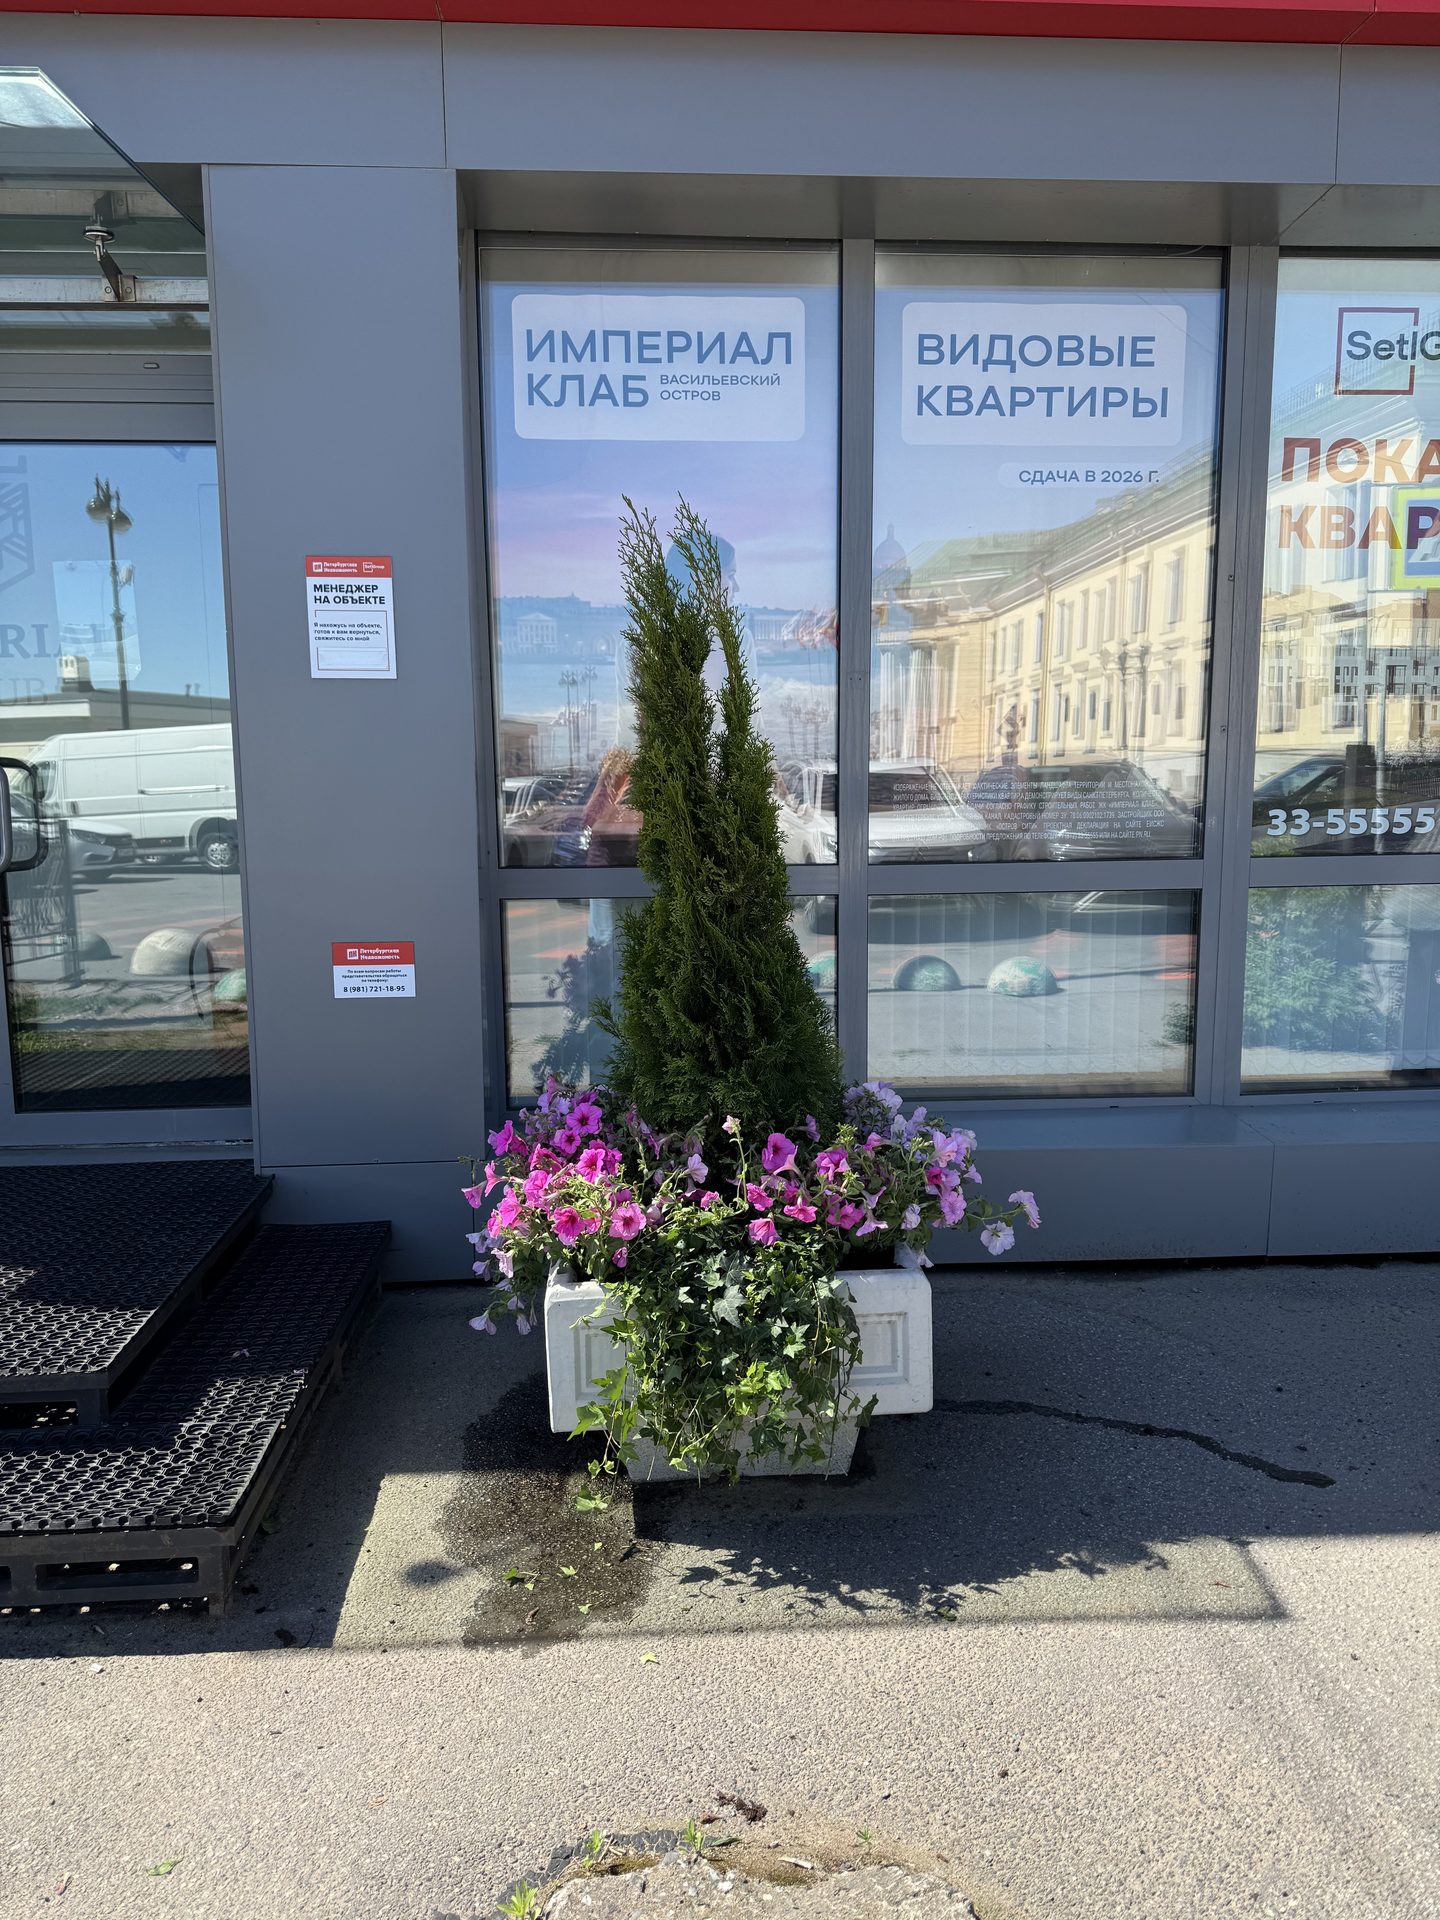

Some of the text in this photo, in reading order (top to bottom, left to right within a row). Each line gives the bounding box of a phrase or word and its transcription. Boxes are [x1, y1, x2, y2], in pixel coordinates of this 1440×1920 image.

[526, 329, 793, 365] ИМПЕРИАЛ
[917, 333, 1156, 373] ВИДОВЫЕ
[527, 373, 649, 408] КЛАБ
[660, 373, 781, 387] ВАСИЛЬЕВСКИЙ
[660, 390, 721, 401] ОСТРОВ
[916, 385, 1168, 418] КВАРТИРЫ
[1019, 470, 1160, 485] СДАЧА В 2026 Г.
[313, 584, 378, 594] МЕНЕДЖЕР
[314, 595, 385, 605] НА ОБЪЕКТЕ
[1266, 807, 1436, 836] 33-55555
